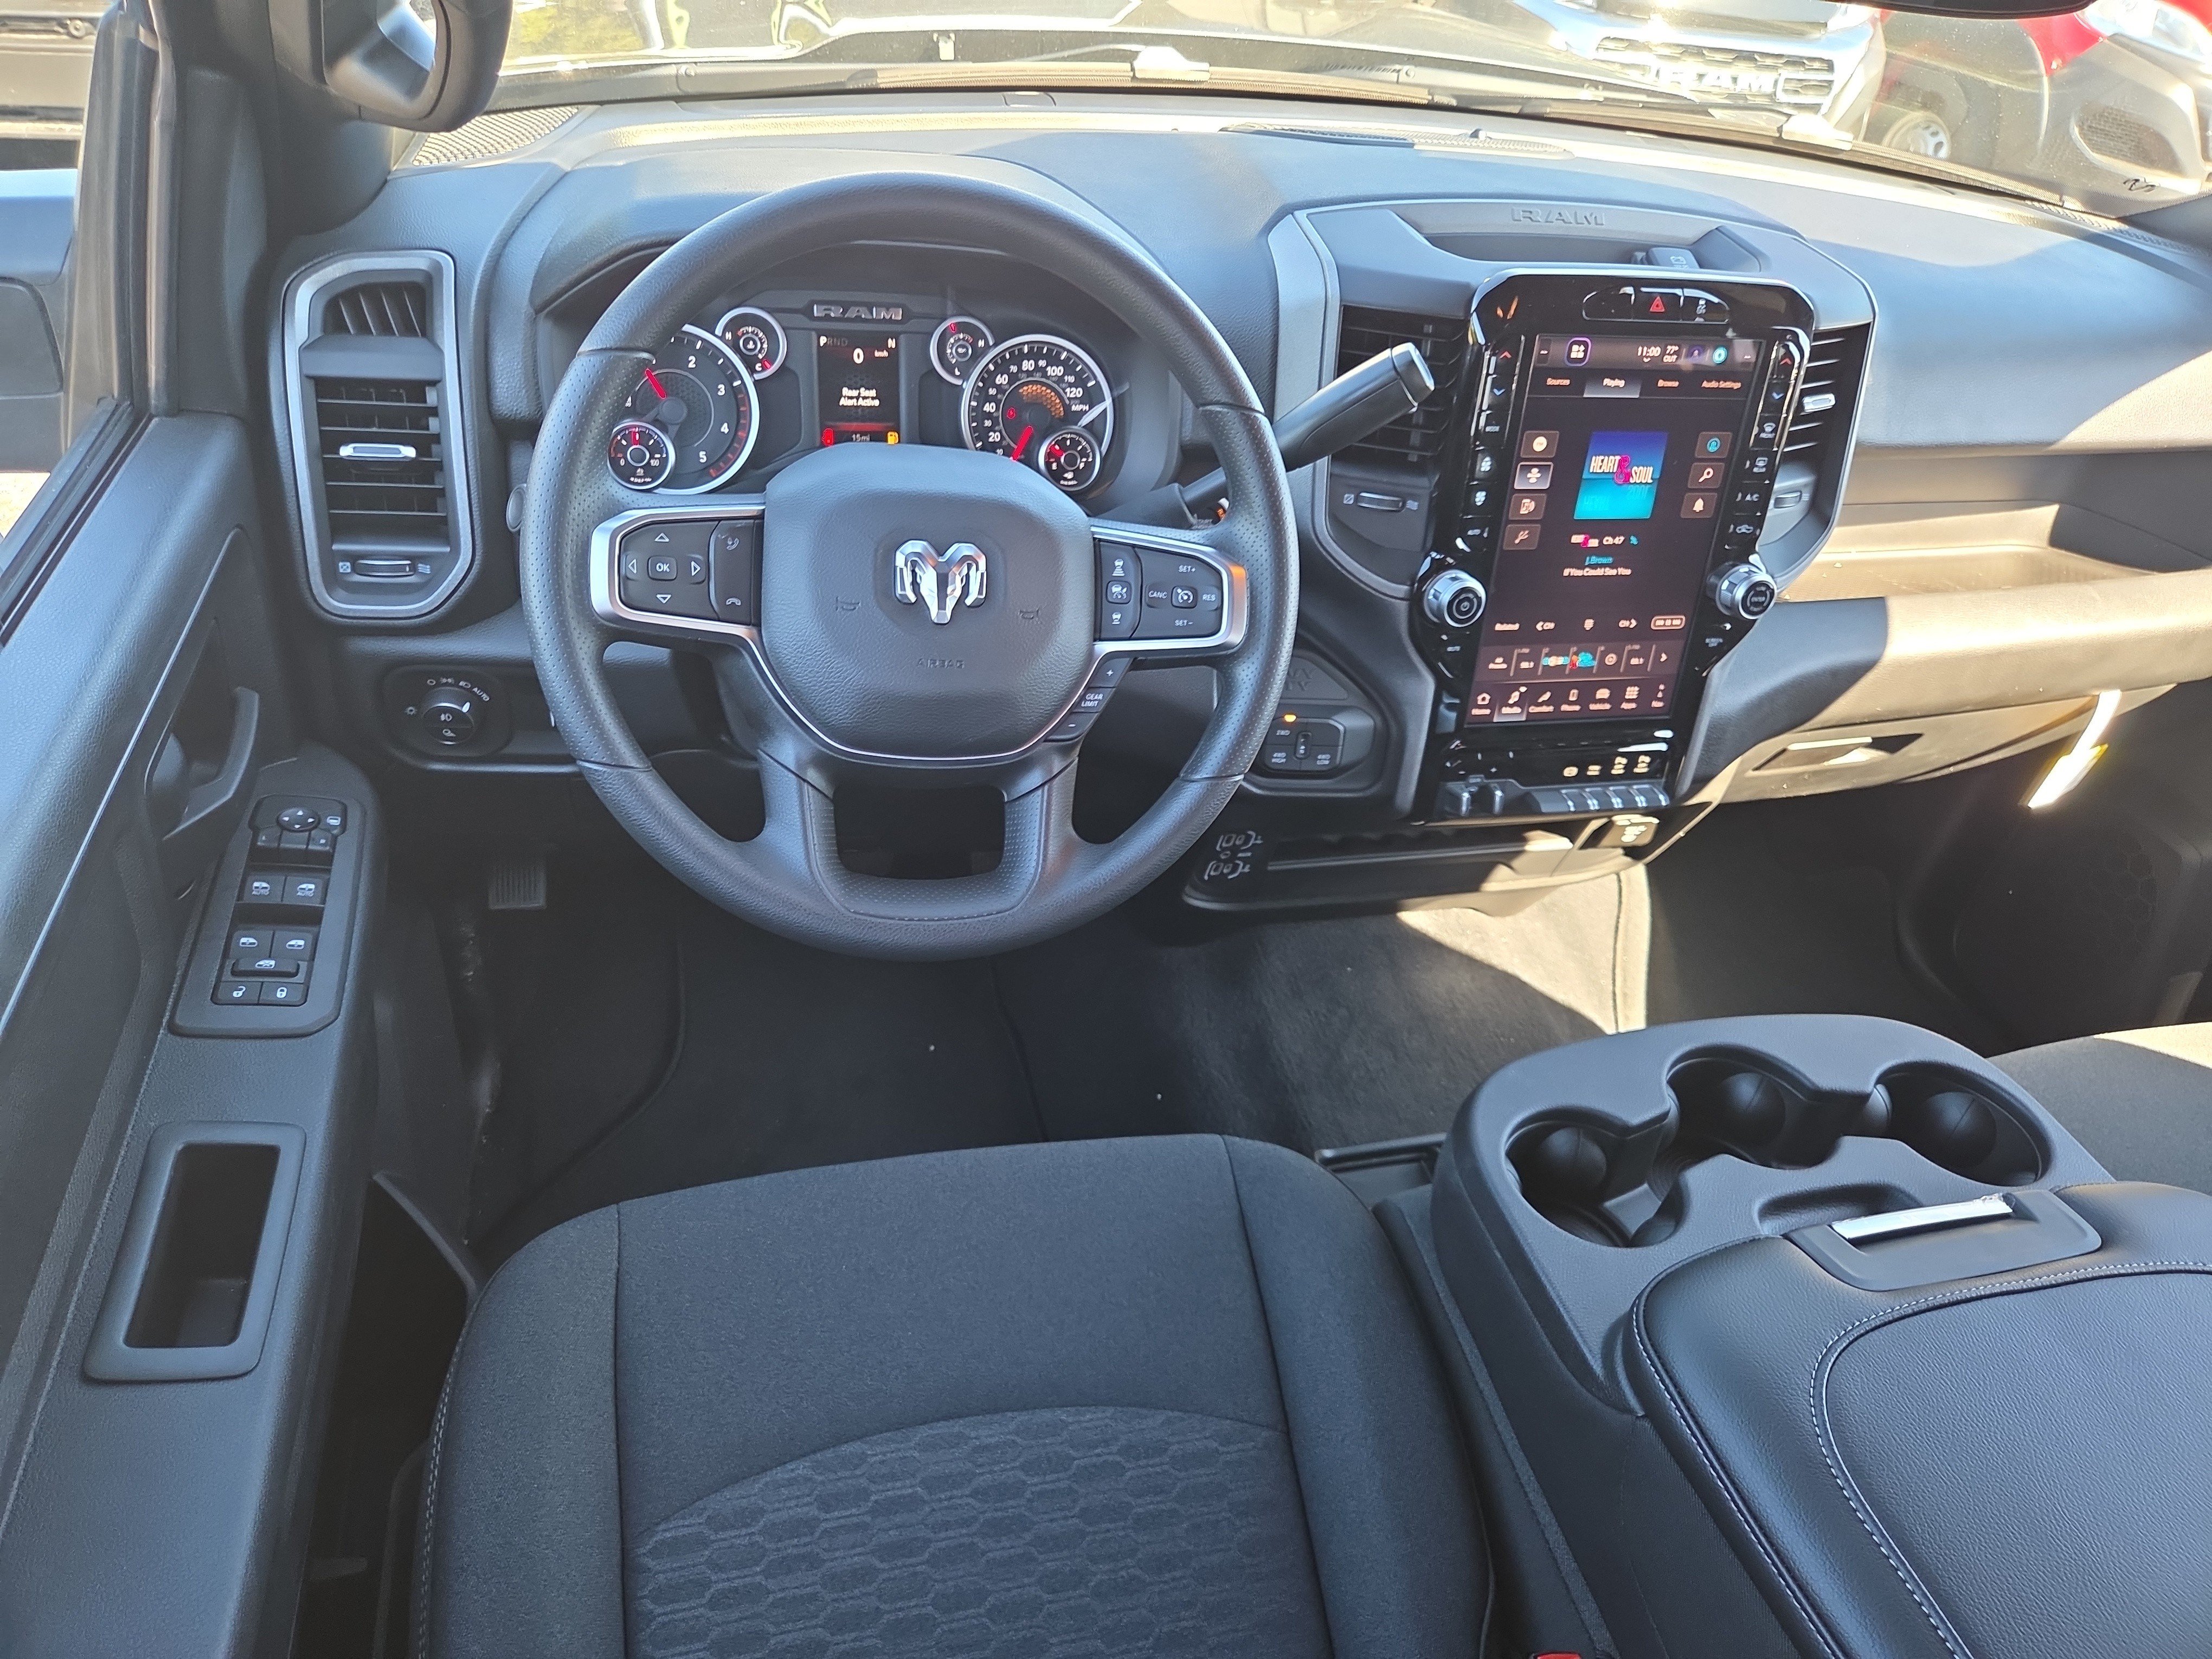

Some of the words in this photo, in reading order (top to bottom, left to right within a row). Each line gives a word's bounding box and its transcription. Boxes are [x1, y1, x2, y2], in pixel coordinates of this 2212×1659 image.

[1659, 67, 1776, 93] RAM
[1512, 208, 1605, 226] RAM
[813, 304, 902, 320] RAM
[888, 338, 896, 349] N
[853, 348, 864, 364] 0
[1637, 346, 1661, 357] 11:00
[688, 356, 696, 368] 2
[1038, 359, 1047, 368] 90
[1663, 355, 1678, 363] OUT
[755, 363, 762, 371] C
[1009, 365, 1018, 373] 70
[1021, 359, 1035, 371] 80
[954, 367, 961, 376] L
[1046, 366, 1064, 376] 100
[995, 374, 1008, 385] 60
[1546, 377, 1571, 385] Sources
[1603, 378, 1625, 388] Playing
[1701, 380, 1719, 388] Audio
[717, 384, 725, 396] 3
[842, 387, 859, 397] Rear
[859, 387, 877, 397] Seat
[988, 387, 997, 395] 50
[1065, 387, 1083, 398] 120
[839, 397, 857, 406] Alert
[857, 397, 880, 407] Active
[983, 402, 996, 413] 40
[721, 422, 729, 434] 4
[983, 419, 992, 427] 30
[988, 432, 1001, 442] 20
[699, 451, 707, 462] 5
[1590, 455, 1622, 473] HEART
[1629, 466, 1654, 484] SOUL
[656, 562, 670, 573] OK
[1570, 568, 1583, 576] You
[1583, 567, 1604, 576] Could
[1604, 567, 1617, 576] See
[1617, 567, 1632, 575] You
[1148, 590, 1167, 599] CANC
[472, 687, 490, 701] AUTO
